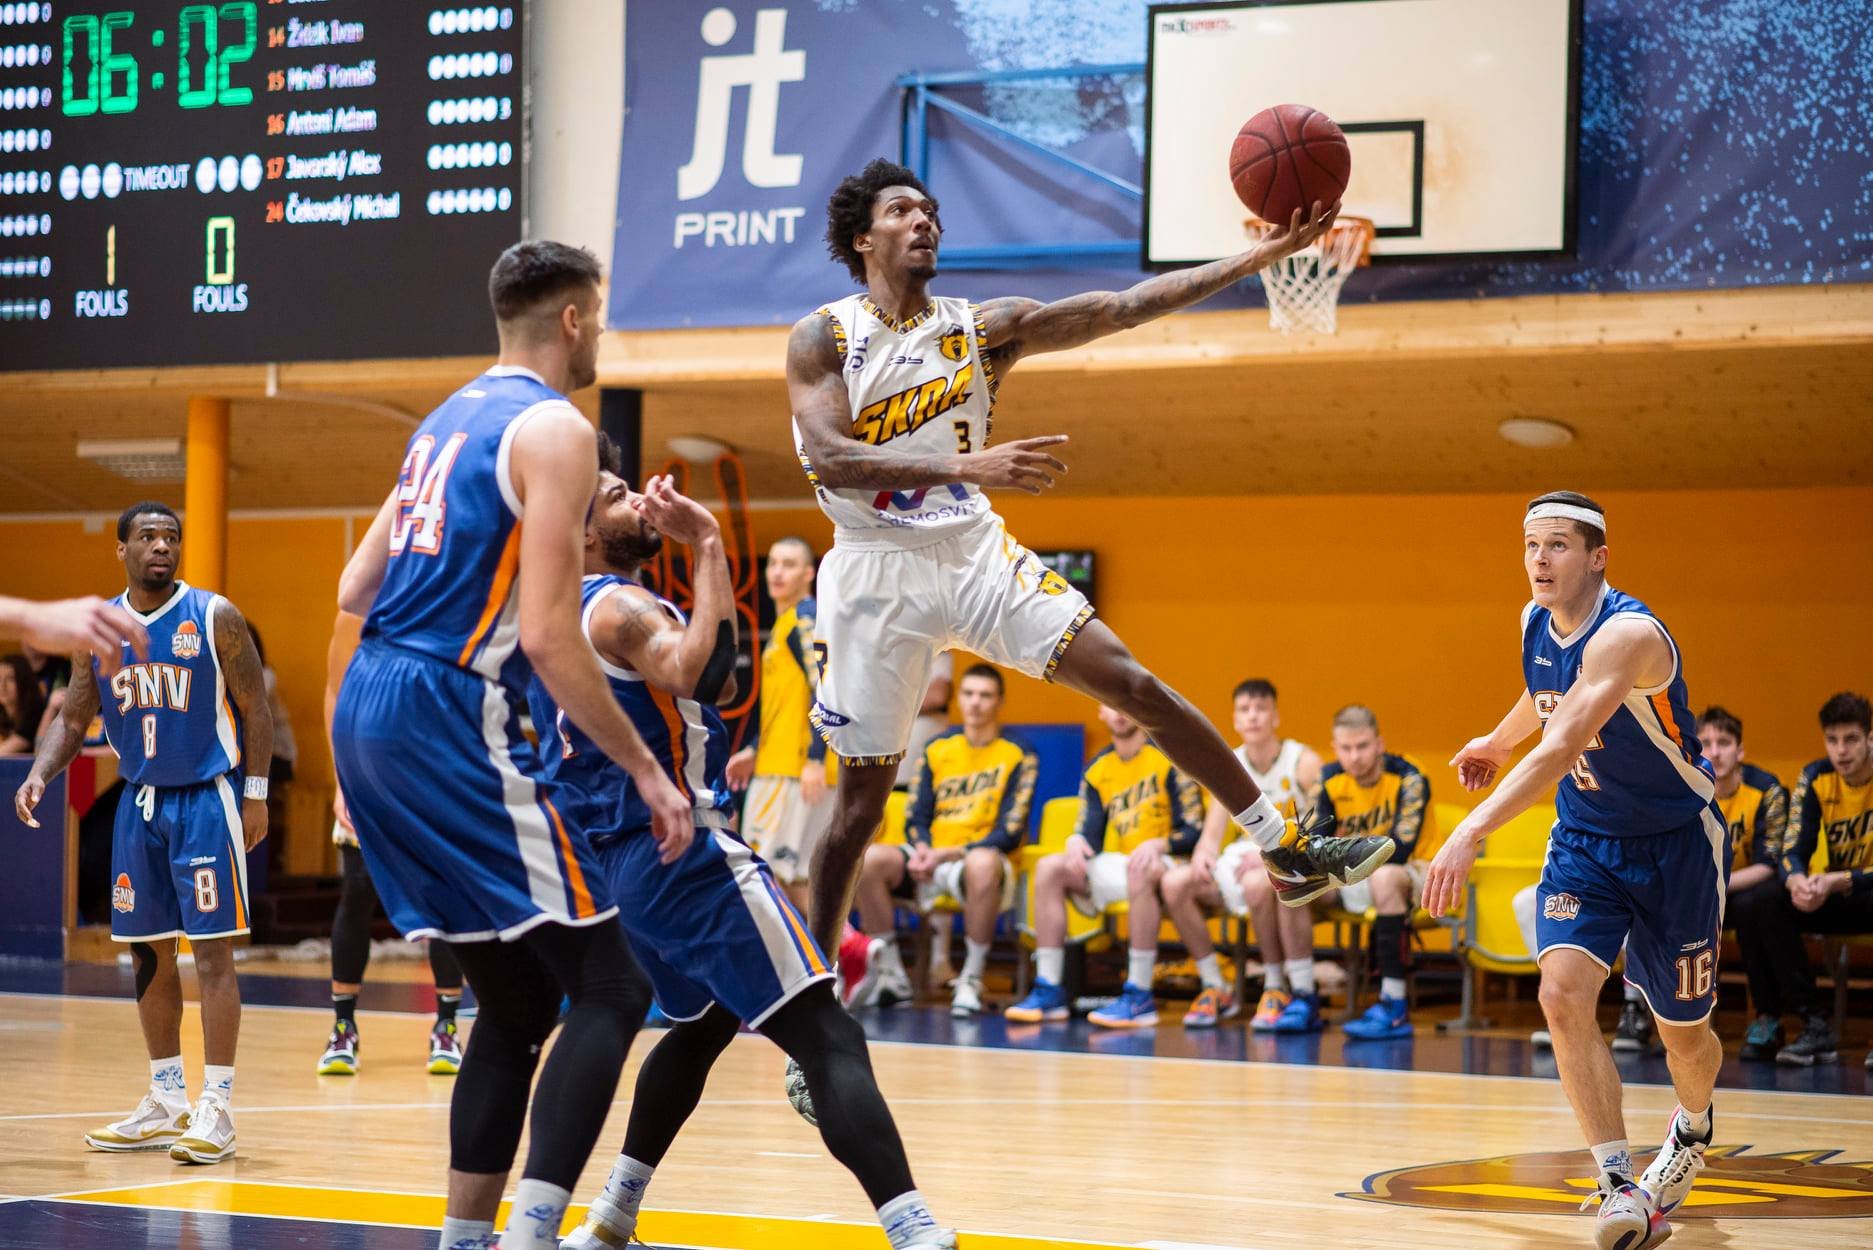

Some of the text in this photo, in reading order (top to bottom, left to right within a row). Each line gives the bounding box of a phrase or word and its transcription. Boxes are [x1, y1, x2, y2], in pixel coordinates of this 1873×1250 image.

[62, 2, 258, 116] 06:02
[267, 114, 285, 135] 16
[334, 106, 377, 133] Adam
[124, 164, 190, 191] TIMEOUT
[267, 157, 285, 179] 17
[348, 150, 382, 175] Alex
[266, 201, 284, 223] 24
[353, 191, 400, 220] Michal
[673, 207, 806, 249] PRINT
[106, 223, 116, 286] 1
[206, 216, 235, 285] 0
[76, 289, 129, 318] FOULS
[193, 284, 248, 313] FOULS
[952, 419, 972, 454] 3
[389, 432, 469, 556] 24
[172, 633, 202, 652] SNV
[111, 662, 193, 716] SNV
[142, 714, 157, 759] 8
[112, 886, 135, 905] SNV
[194, 868, 218, 912] 8
[1545, 893, 1580, 913] SNV
[1675, 950, 1713, 1001] 16
